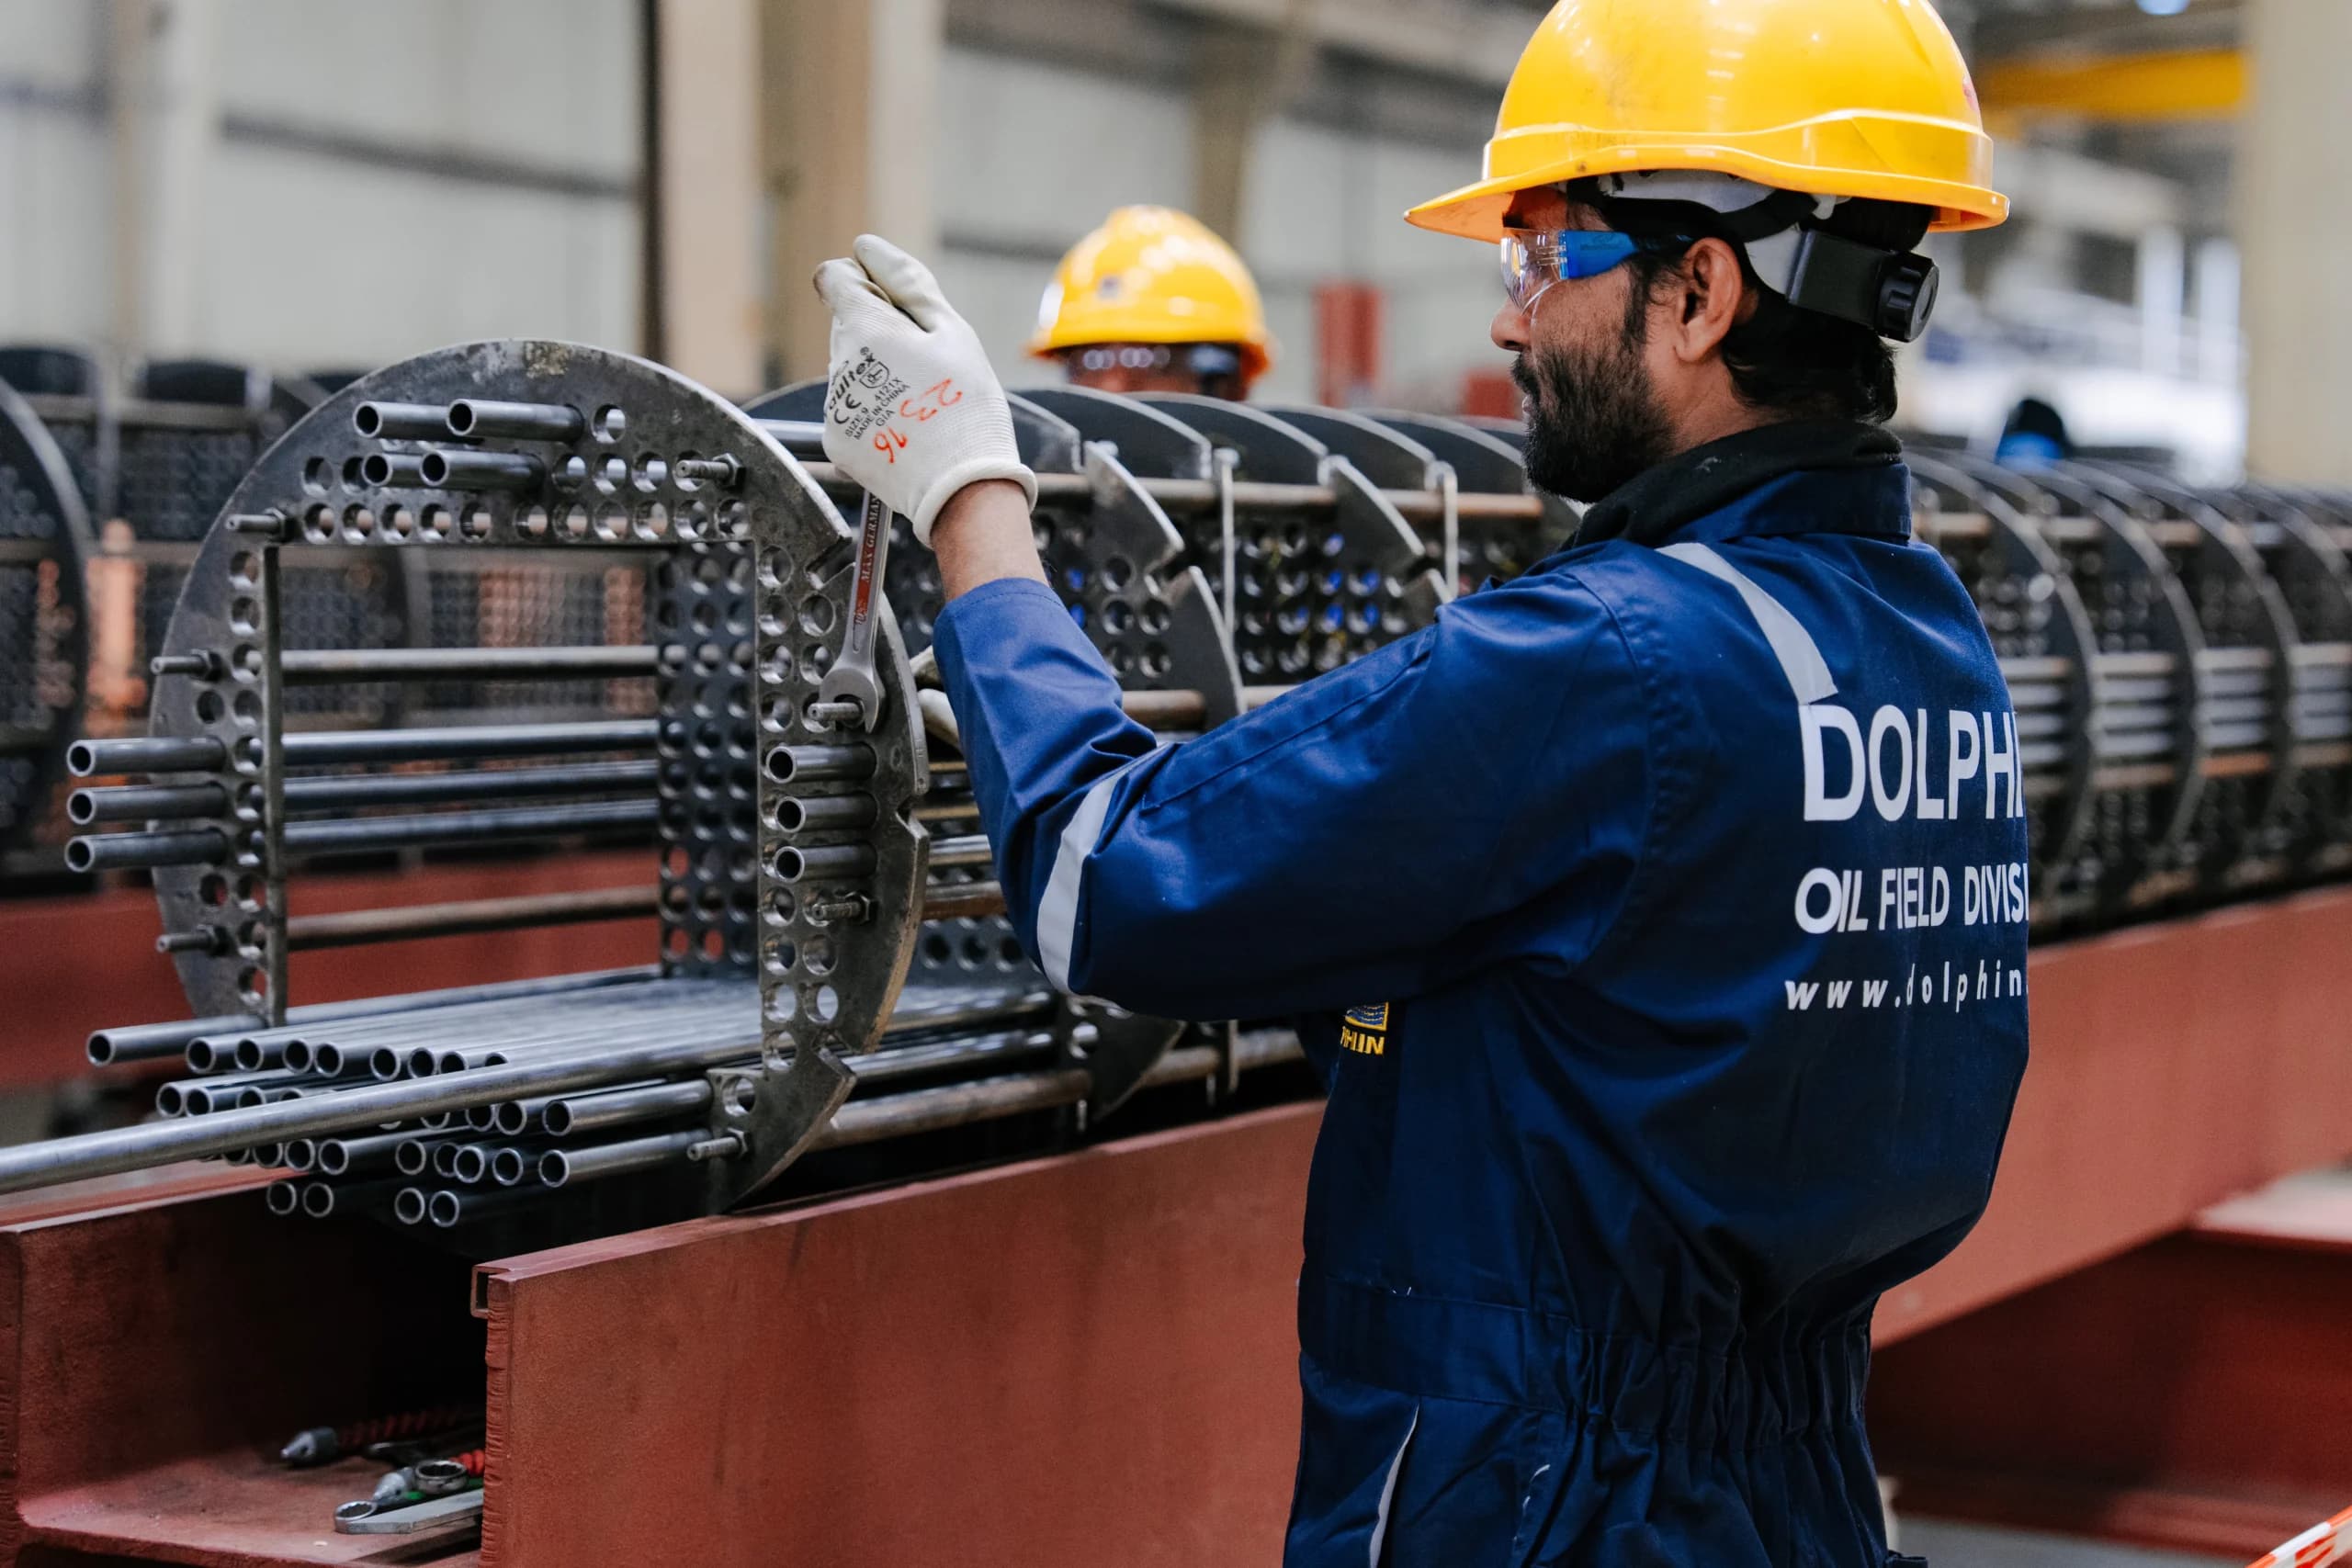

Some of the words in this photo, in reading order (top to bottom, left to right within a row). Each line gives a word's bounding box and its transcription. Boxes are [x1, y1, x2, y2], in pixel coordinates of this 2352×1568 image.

[828, 352, 876, 412] aultex
[854, 415, 874, 440] MADE
[872, 405, 882, 416] IN
[881, 383, 911, 407] CHINA
[1798, 705, 2025, 821] DOLPHI
[1794, 867, 1869, 934] OIL
[1878, 866, 1951, 930] FIELD
[1784, 959, 2029, 1013] www.dolphin
